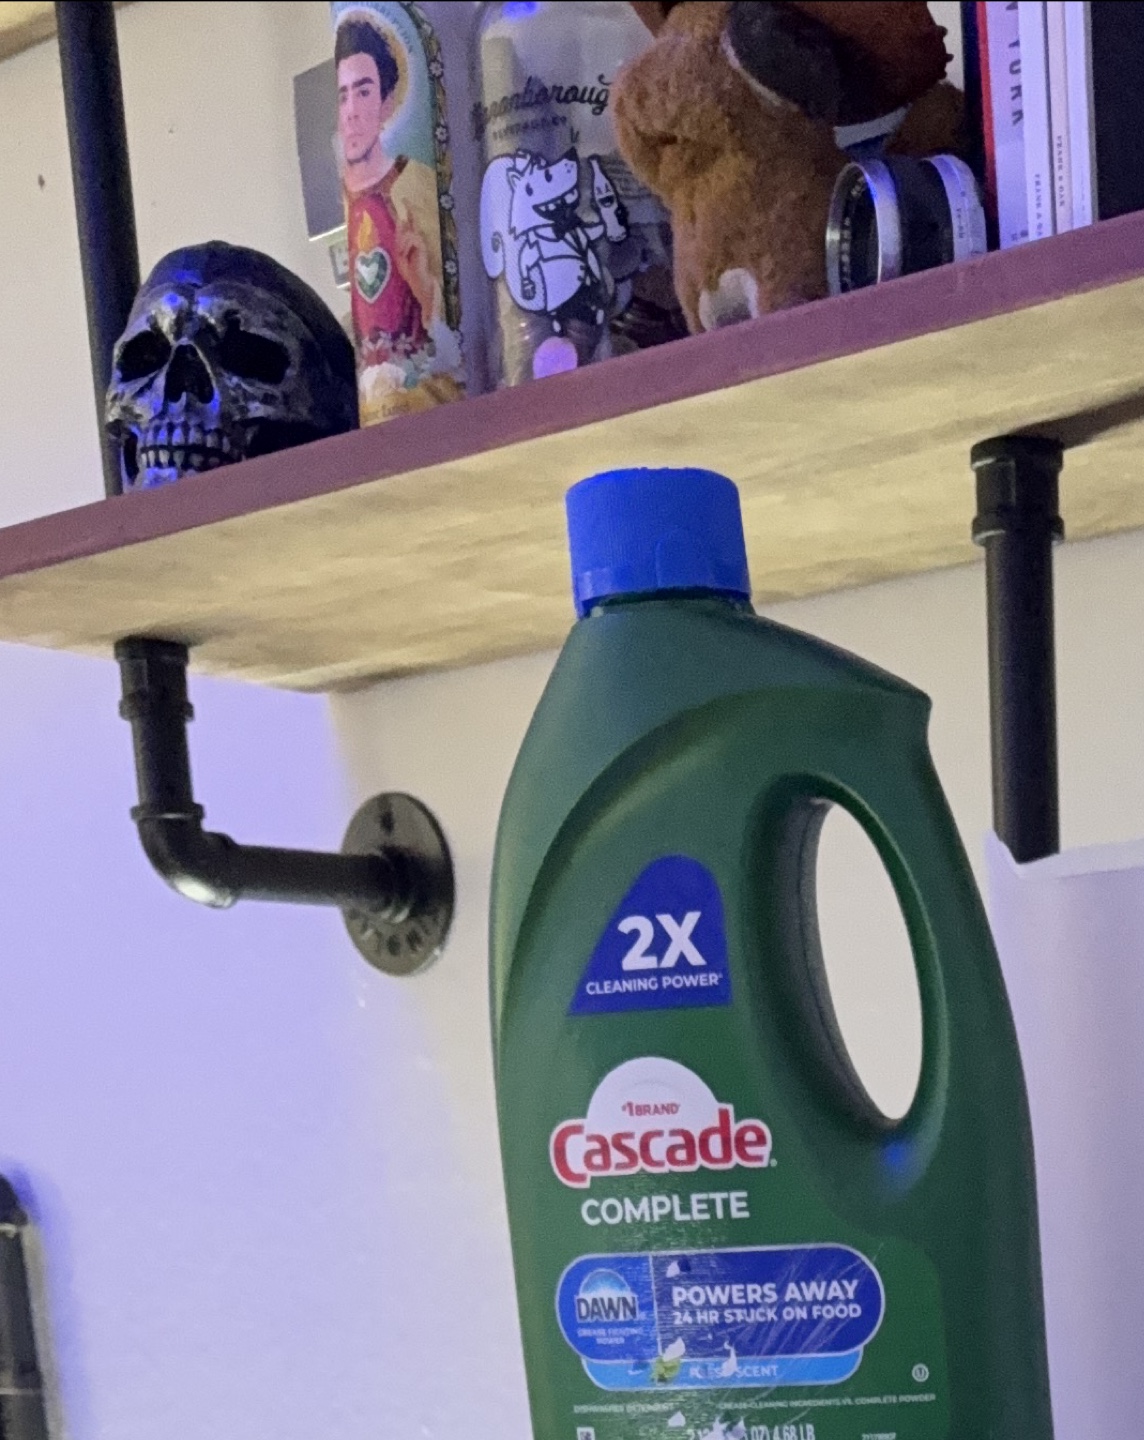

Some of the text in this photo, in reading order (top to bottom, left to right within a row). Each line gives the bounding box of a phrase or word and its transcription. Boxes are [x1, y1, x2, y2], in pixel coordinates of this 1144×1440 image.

[617, 911, 708, 972] 2X
[586, 976, 659, 995] CLEANING
[553, 1107, 768, 1184] Cascade
[581, 1191, 750, 1226] COMPLETE
[672, 1279, 860, 1308] POWERS AWAY
[577, 1296, 638, 1321] DAWN
[673, 1303, 862, 1326] 24 HR STUCK ON FOOD
[736, 1365, 779, 1378] SCENT
[855, 1396, 897, 1405] COMPLETE
[899, 1393, 936, 1402] POWDER
